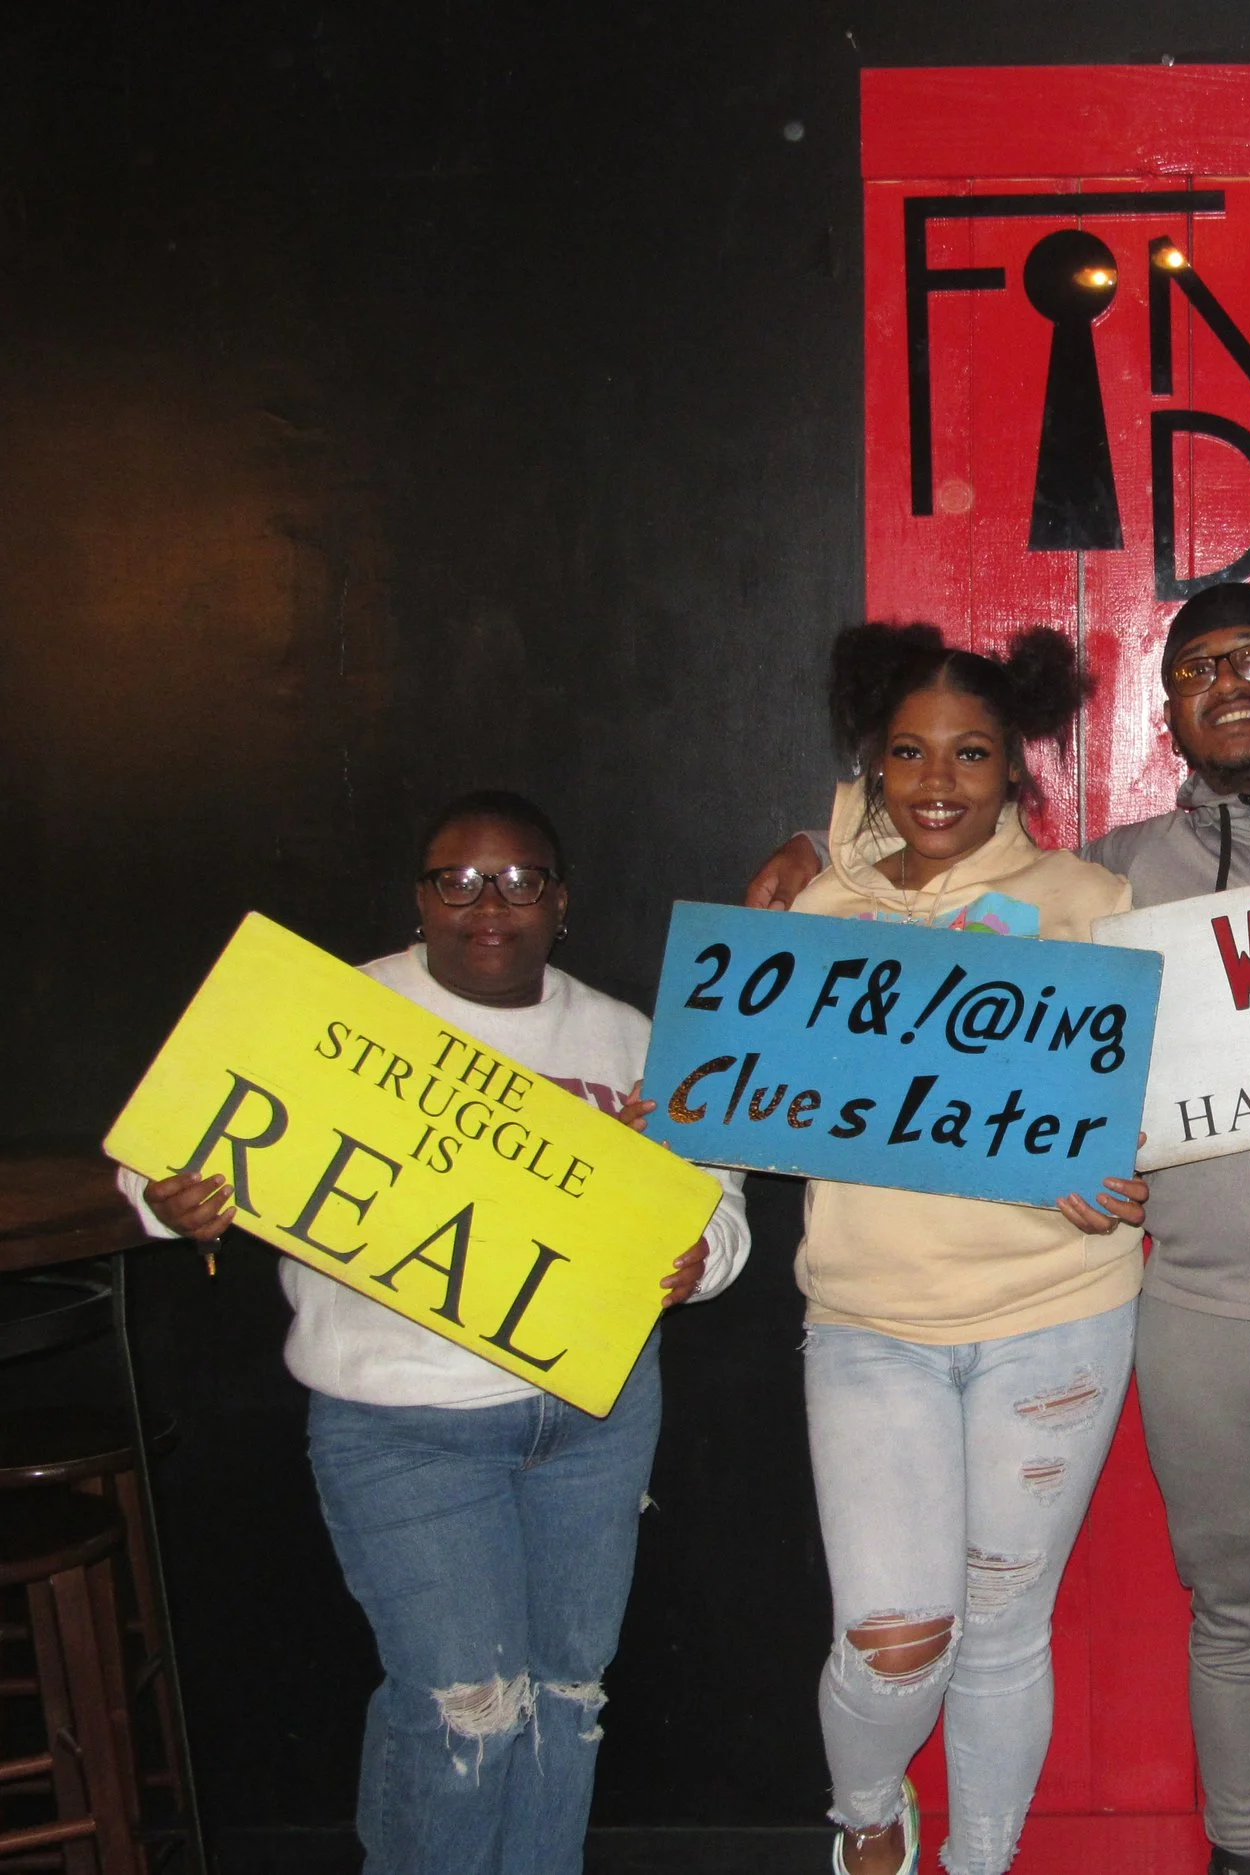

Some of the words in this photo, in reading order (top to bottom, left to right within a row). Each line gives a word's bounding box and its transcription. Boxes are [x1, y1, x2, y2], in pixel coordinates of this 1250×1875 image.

[684, 943, 796, 1016] 20
[314, 1021, 595, 1198] STRUGGLE
[431, 1030, 535, 1113] THE
[667, 1052, 877, 1139] Clues
[887, 1074, 1108, 1159] Later
[408, 1124, 463, 1175] IS
[167, 1068, 571, 1373] REAL
